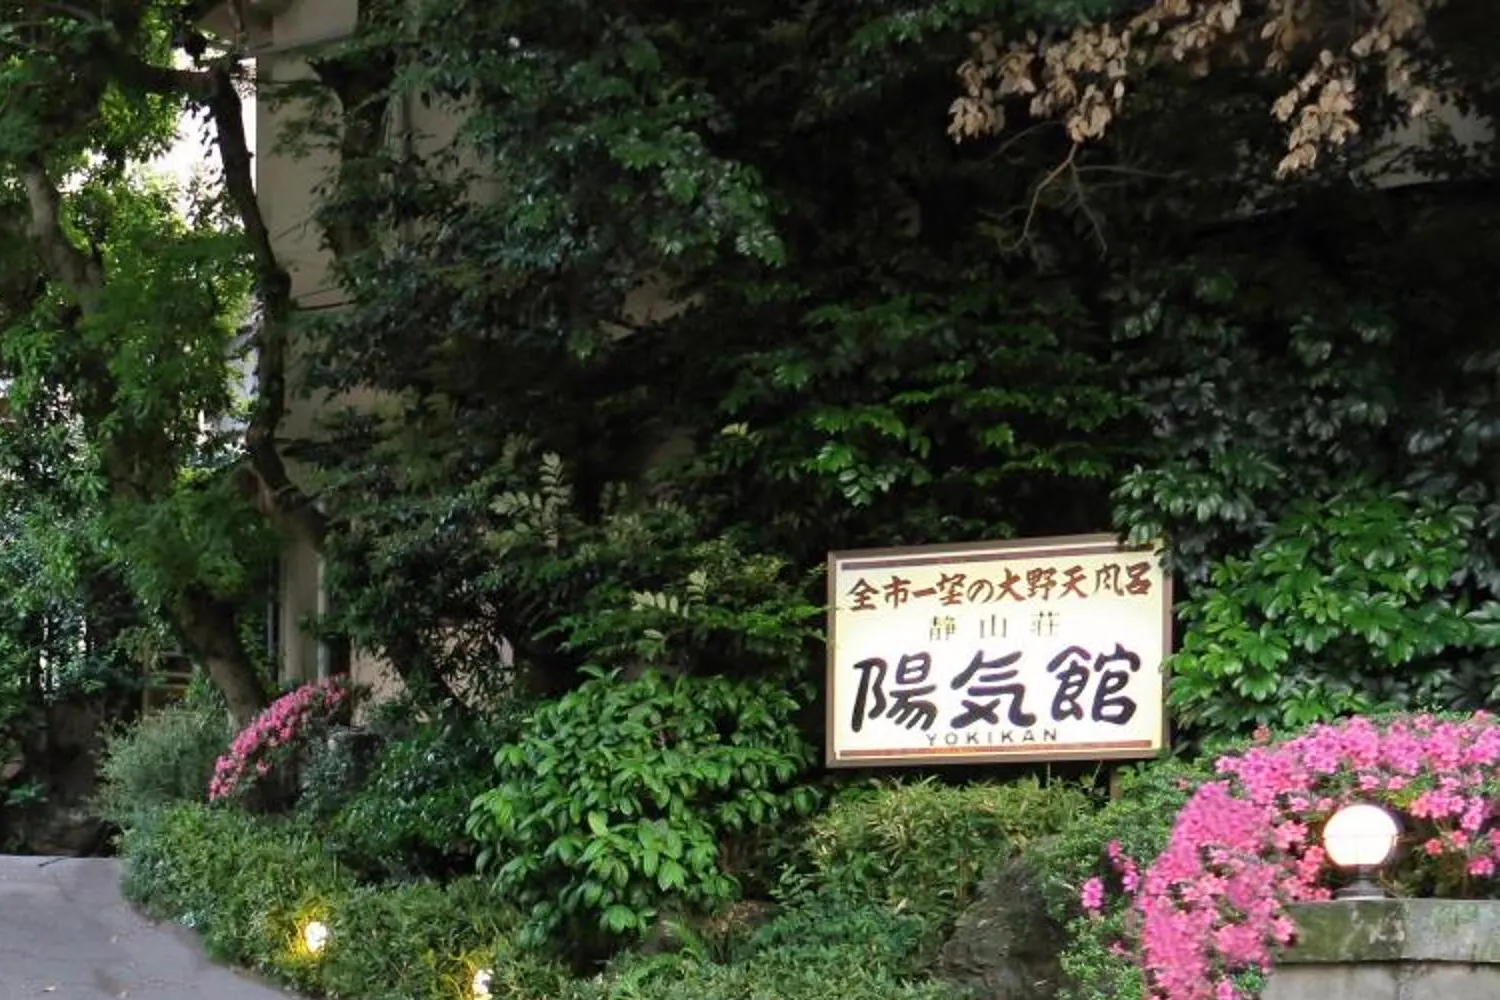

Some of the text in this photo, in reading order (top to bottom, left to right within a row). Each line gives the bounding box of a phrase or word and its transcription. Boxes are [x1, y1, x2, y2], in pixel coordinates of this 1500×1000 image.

[850, 643, 1142, 733] 陽気館
[925, 729, 1060, 747] YOKIKAN
